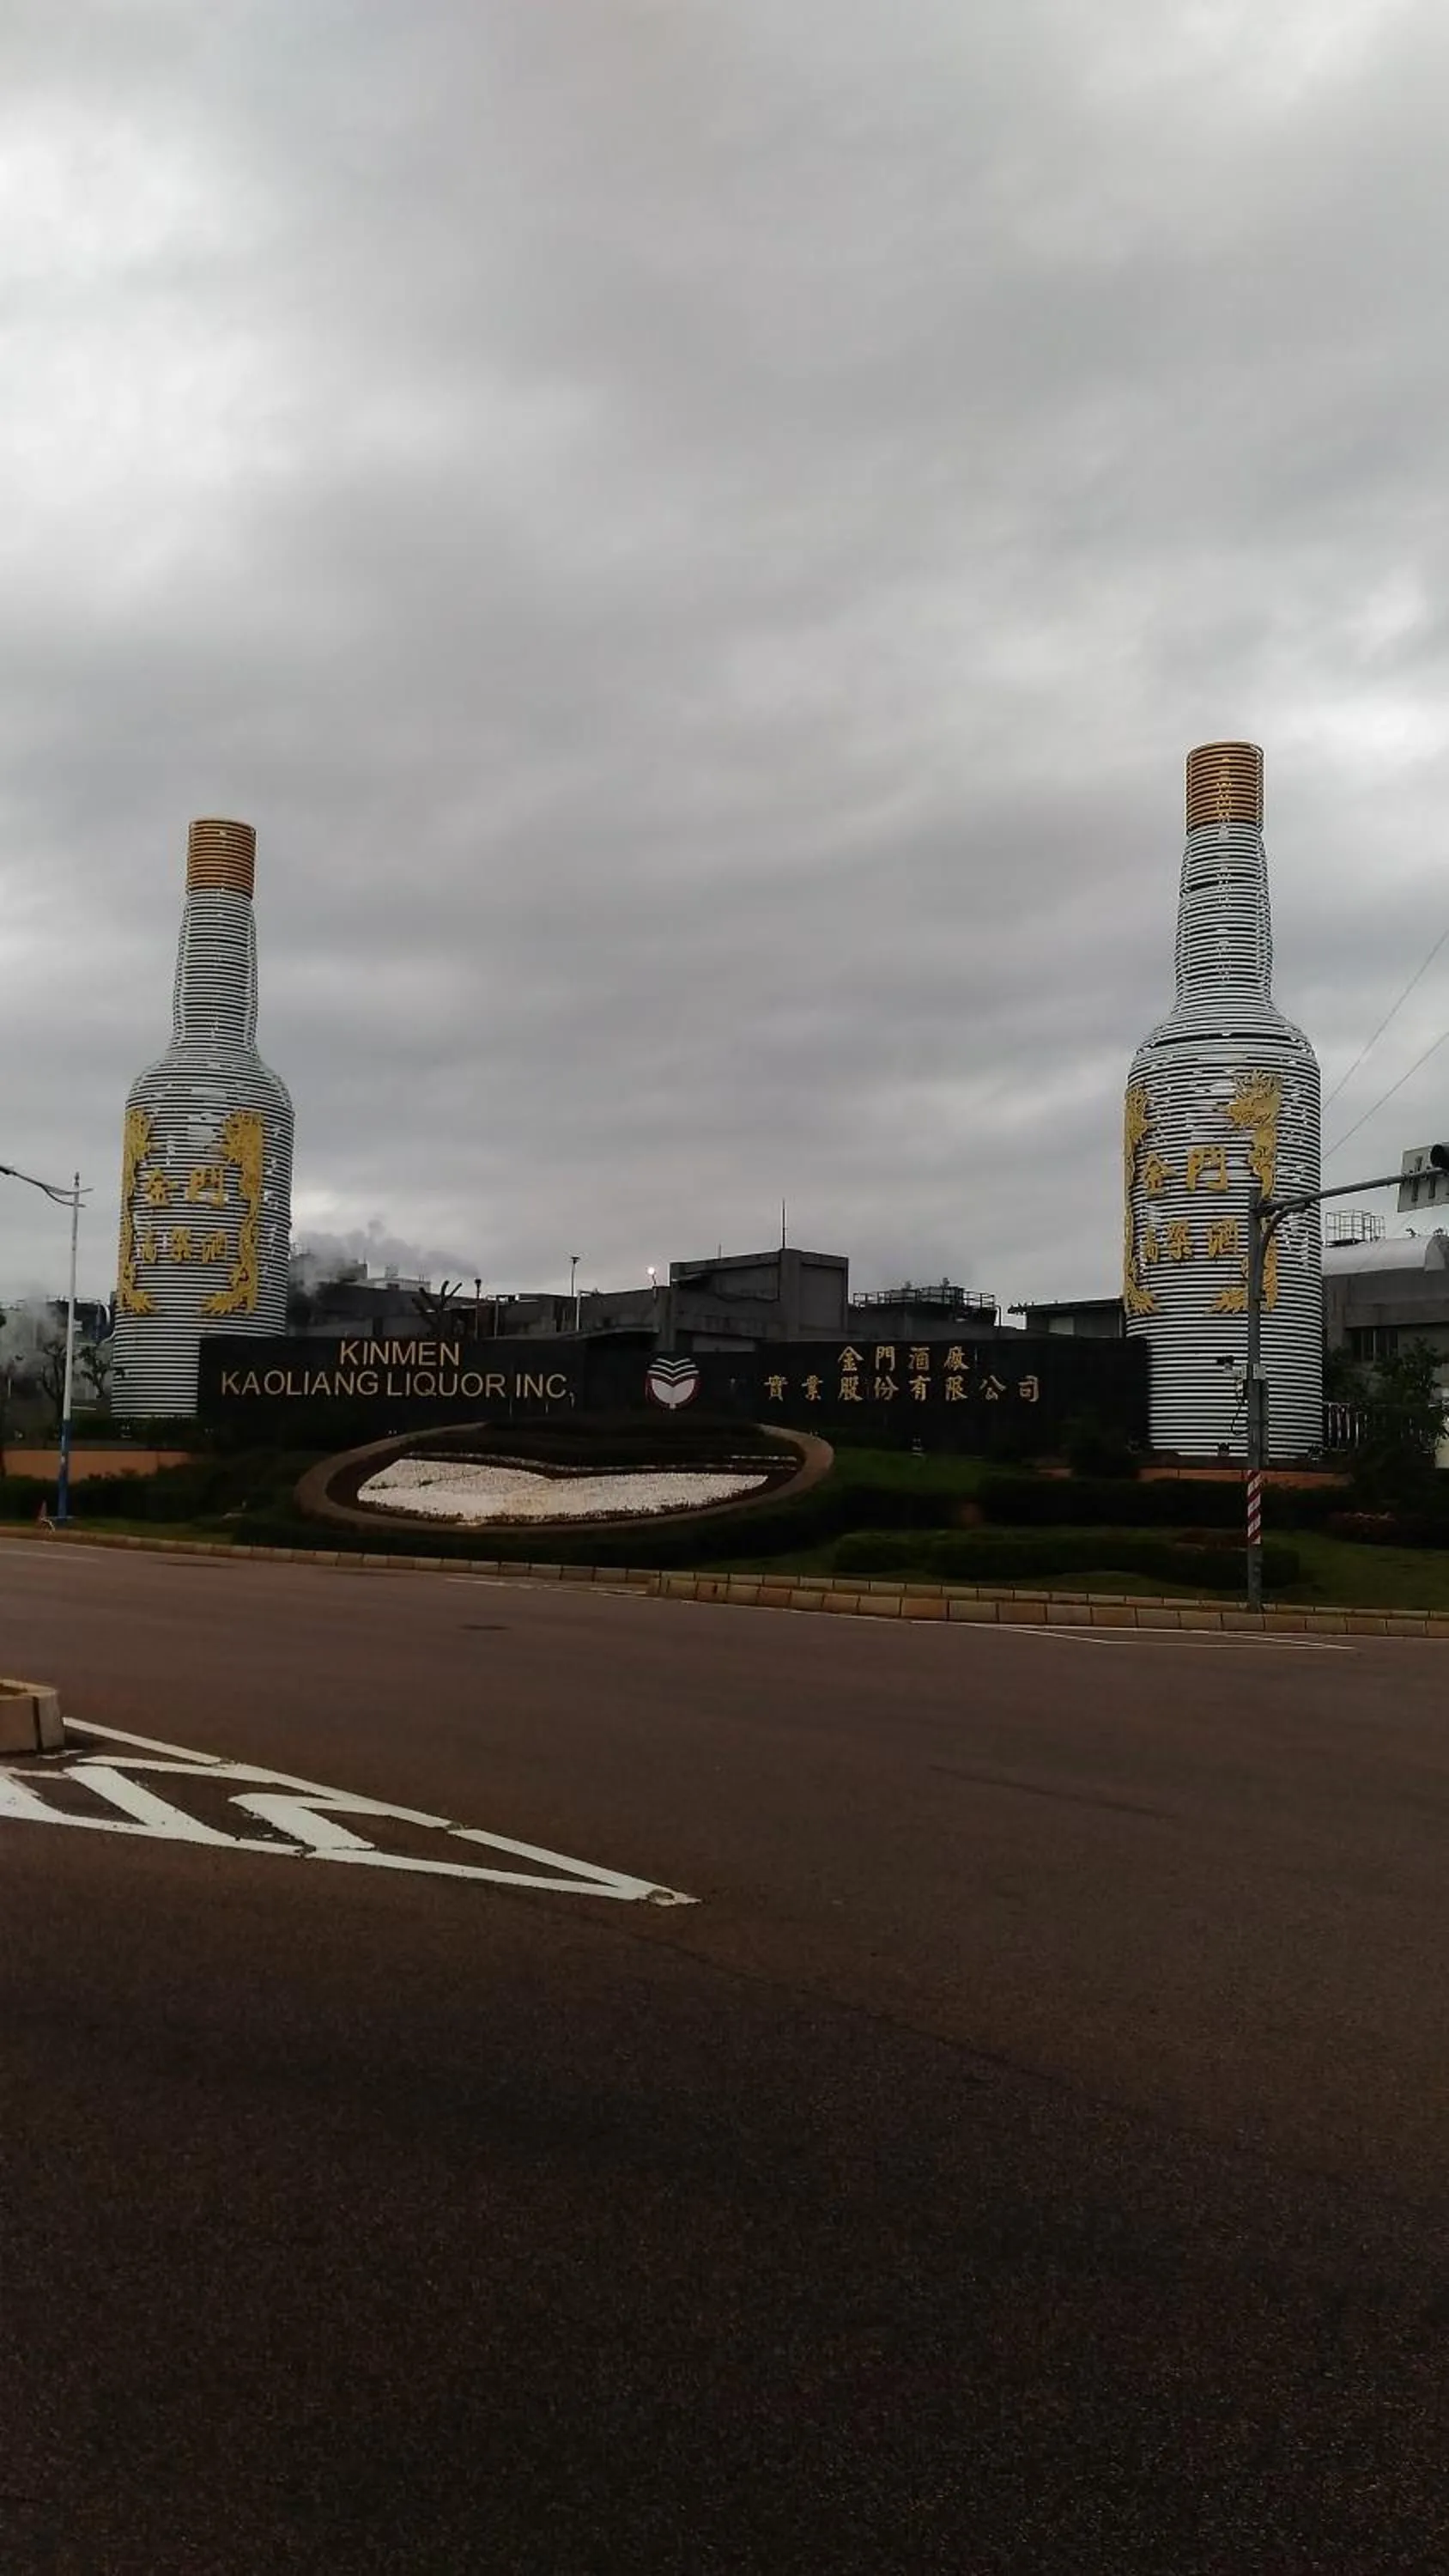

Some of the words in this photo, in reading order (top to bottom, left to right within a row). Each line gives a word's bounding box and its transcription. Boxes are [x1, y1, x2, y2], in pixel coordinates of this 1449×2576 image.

[1144, 1147, 1228, 1194] 金門
[340, 1341, 460, 1365] KINMEN
[838, 1346, 969, 1371] 金門酒廠
[221, 1371, 379, 1396] KAOLIANG
[387, 1372, 506, 1397] LIQUOR
[764, 1375, 1040, 1401] 實業股份有限公司
